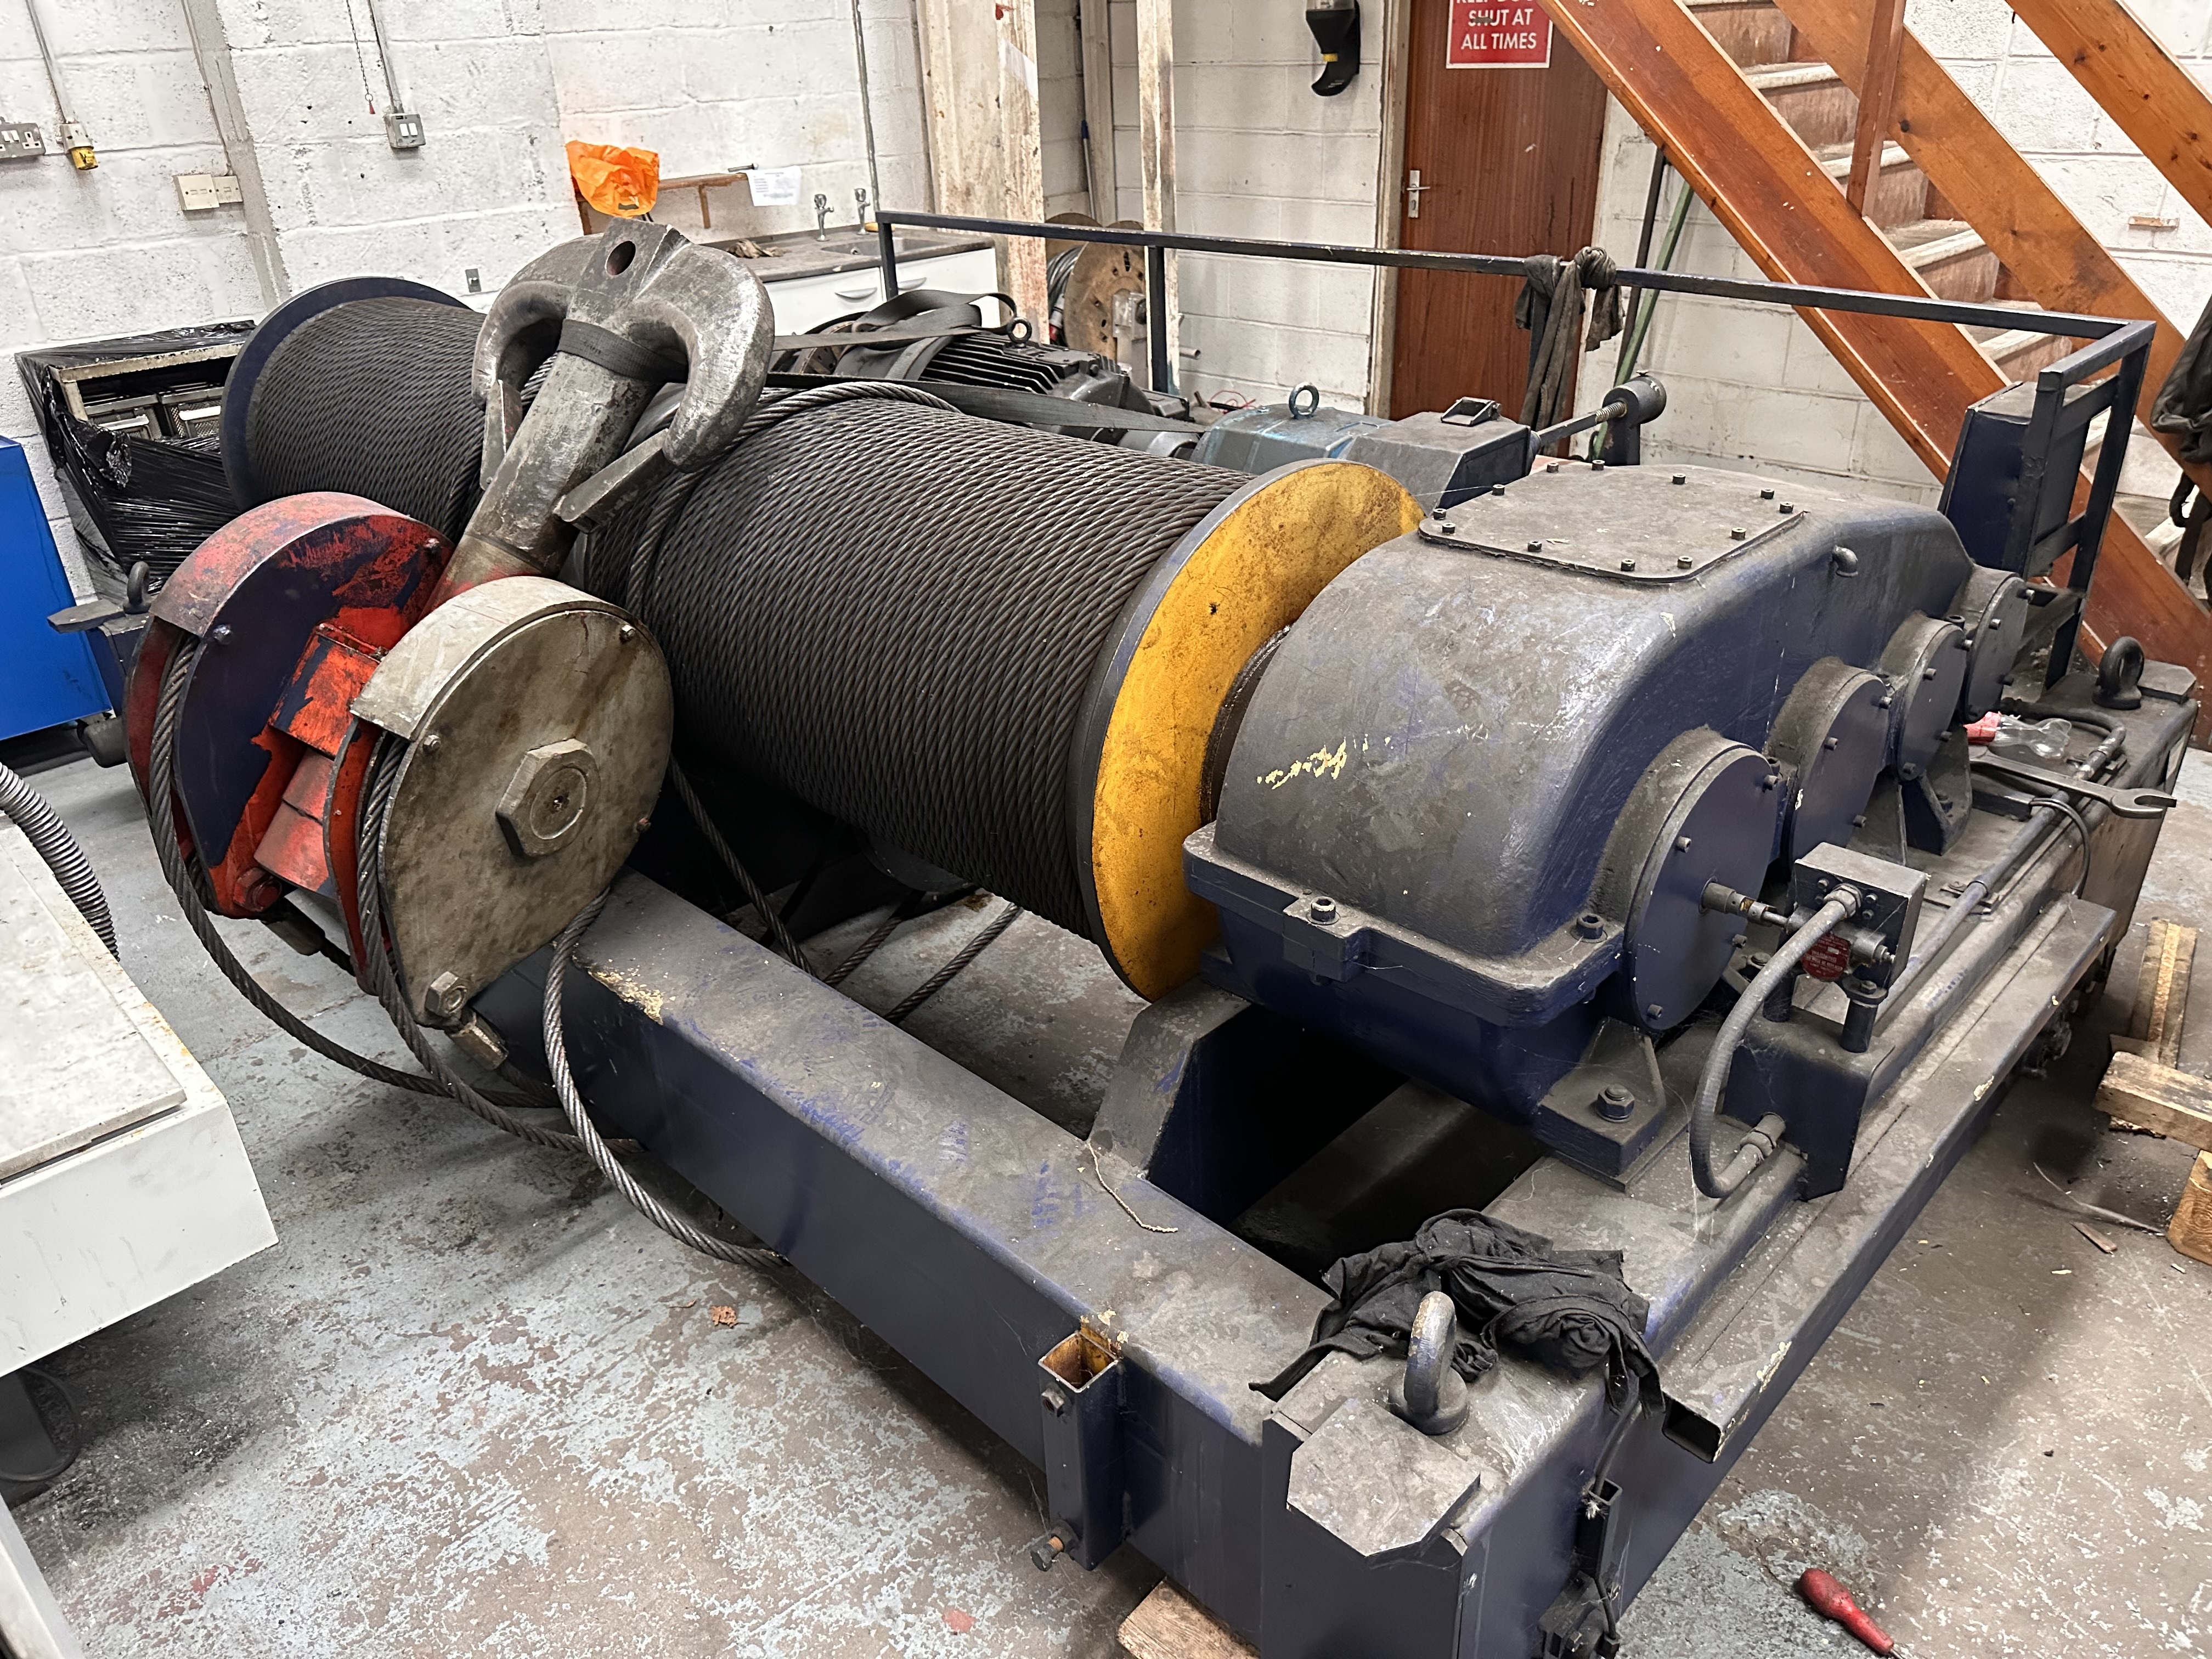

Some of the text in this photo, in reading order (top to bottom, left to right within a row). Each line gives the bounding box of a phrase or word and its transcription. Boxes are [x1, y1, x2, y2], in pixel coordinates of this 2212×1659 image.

[1468, 8, 1533, 26] SHUT AT
[1460, 32, 1537, 50] ALL TIMES
